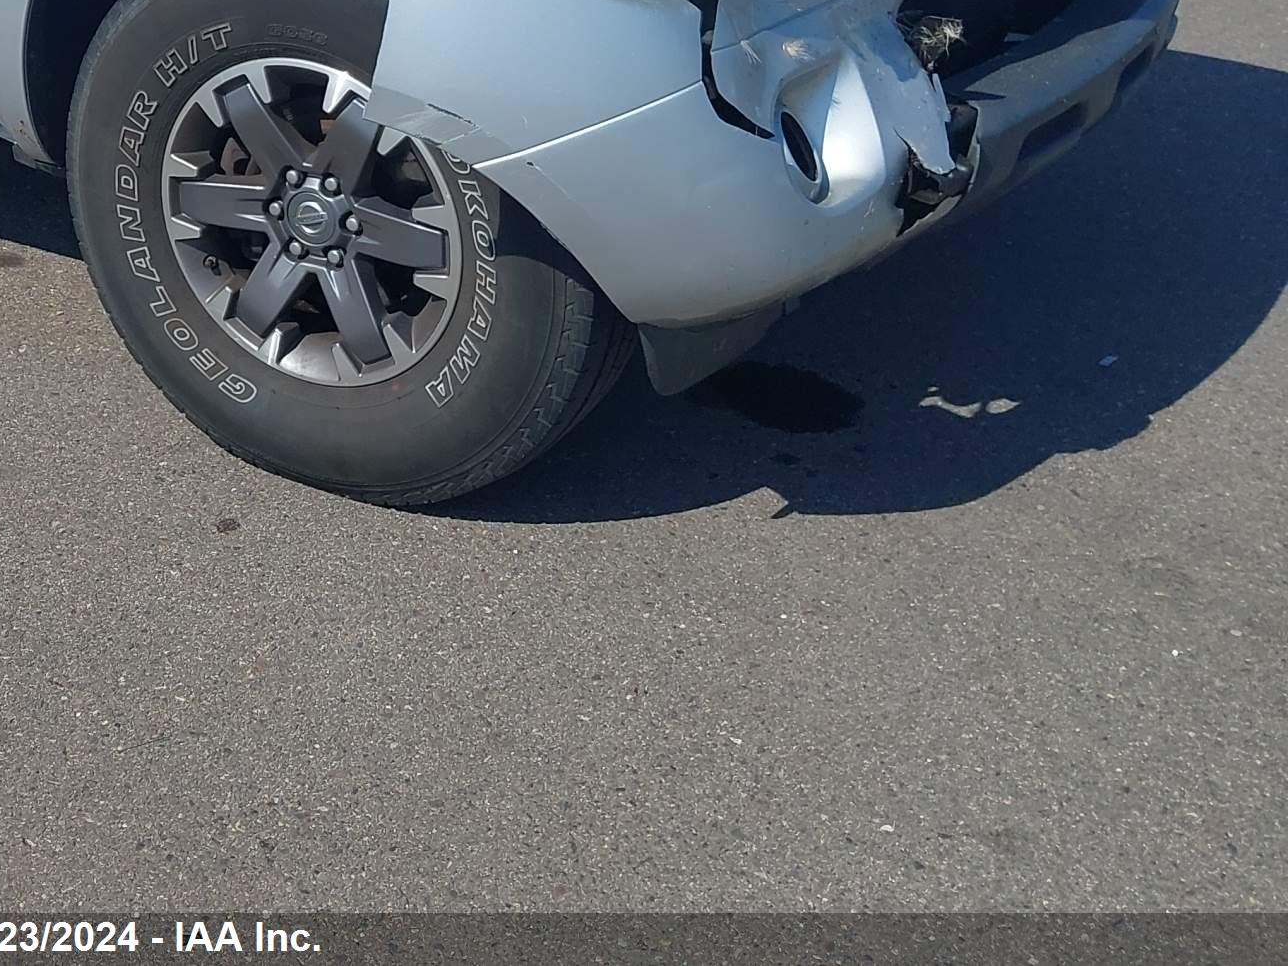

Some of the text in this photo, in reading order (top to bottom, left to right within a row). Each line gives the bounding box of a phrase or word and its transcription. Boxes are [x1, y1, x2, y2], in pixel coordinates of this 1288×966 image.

[110, 22, 258, 406] GEOLANDAR H/T
[426, 150, 500, 408] KOHAMA
